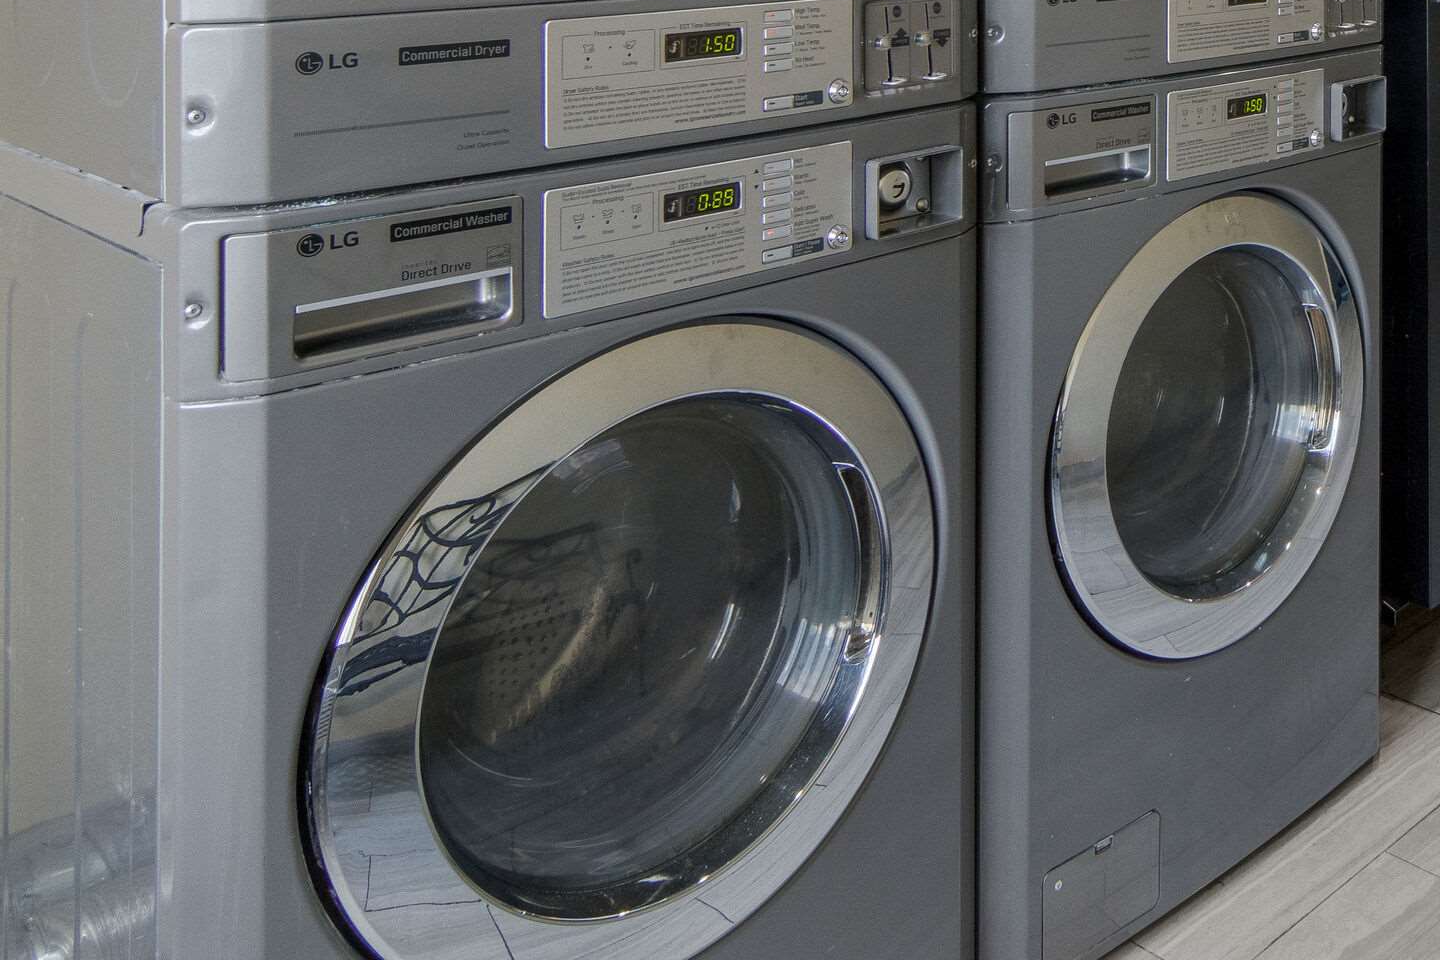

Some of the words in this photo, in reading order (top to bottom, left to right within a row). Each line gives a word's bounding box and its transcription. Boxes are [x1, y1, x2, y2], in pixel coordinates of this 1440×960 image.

[401, 46, 472, 63] Commercial
[475, 43, 507, 57] Dryer
[705, 34, 736, 53] 1.50
[329, 52, 359, 70] LG
[393, 217, 464, 239] Commercial
[465, 210, 510, 227] Washer
[330, 231, 359, 249] LG
[401, 266, 438, 281] Direct
[441, 262, 472, 274] Drive
